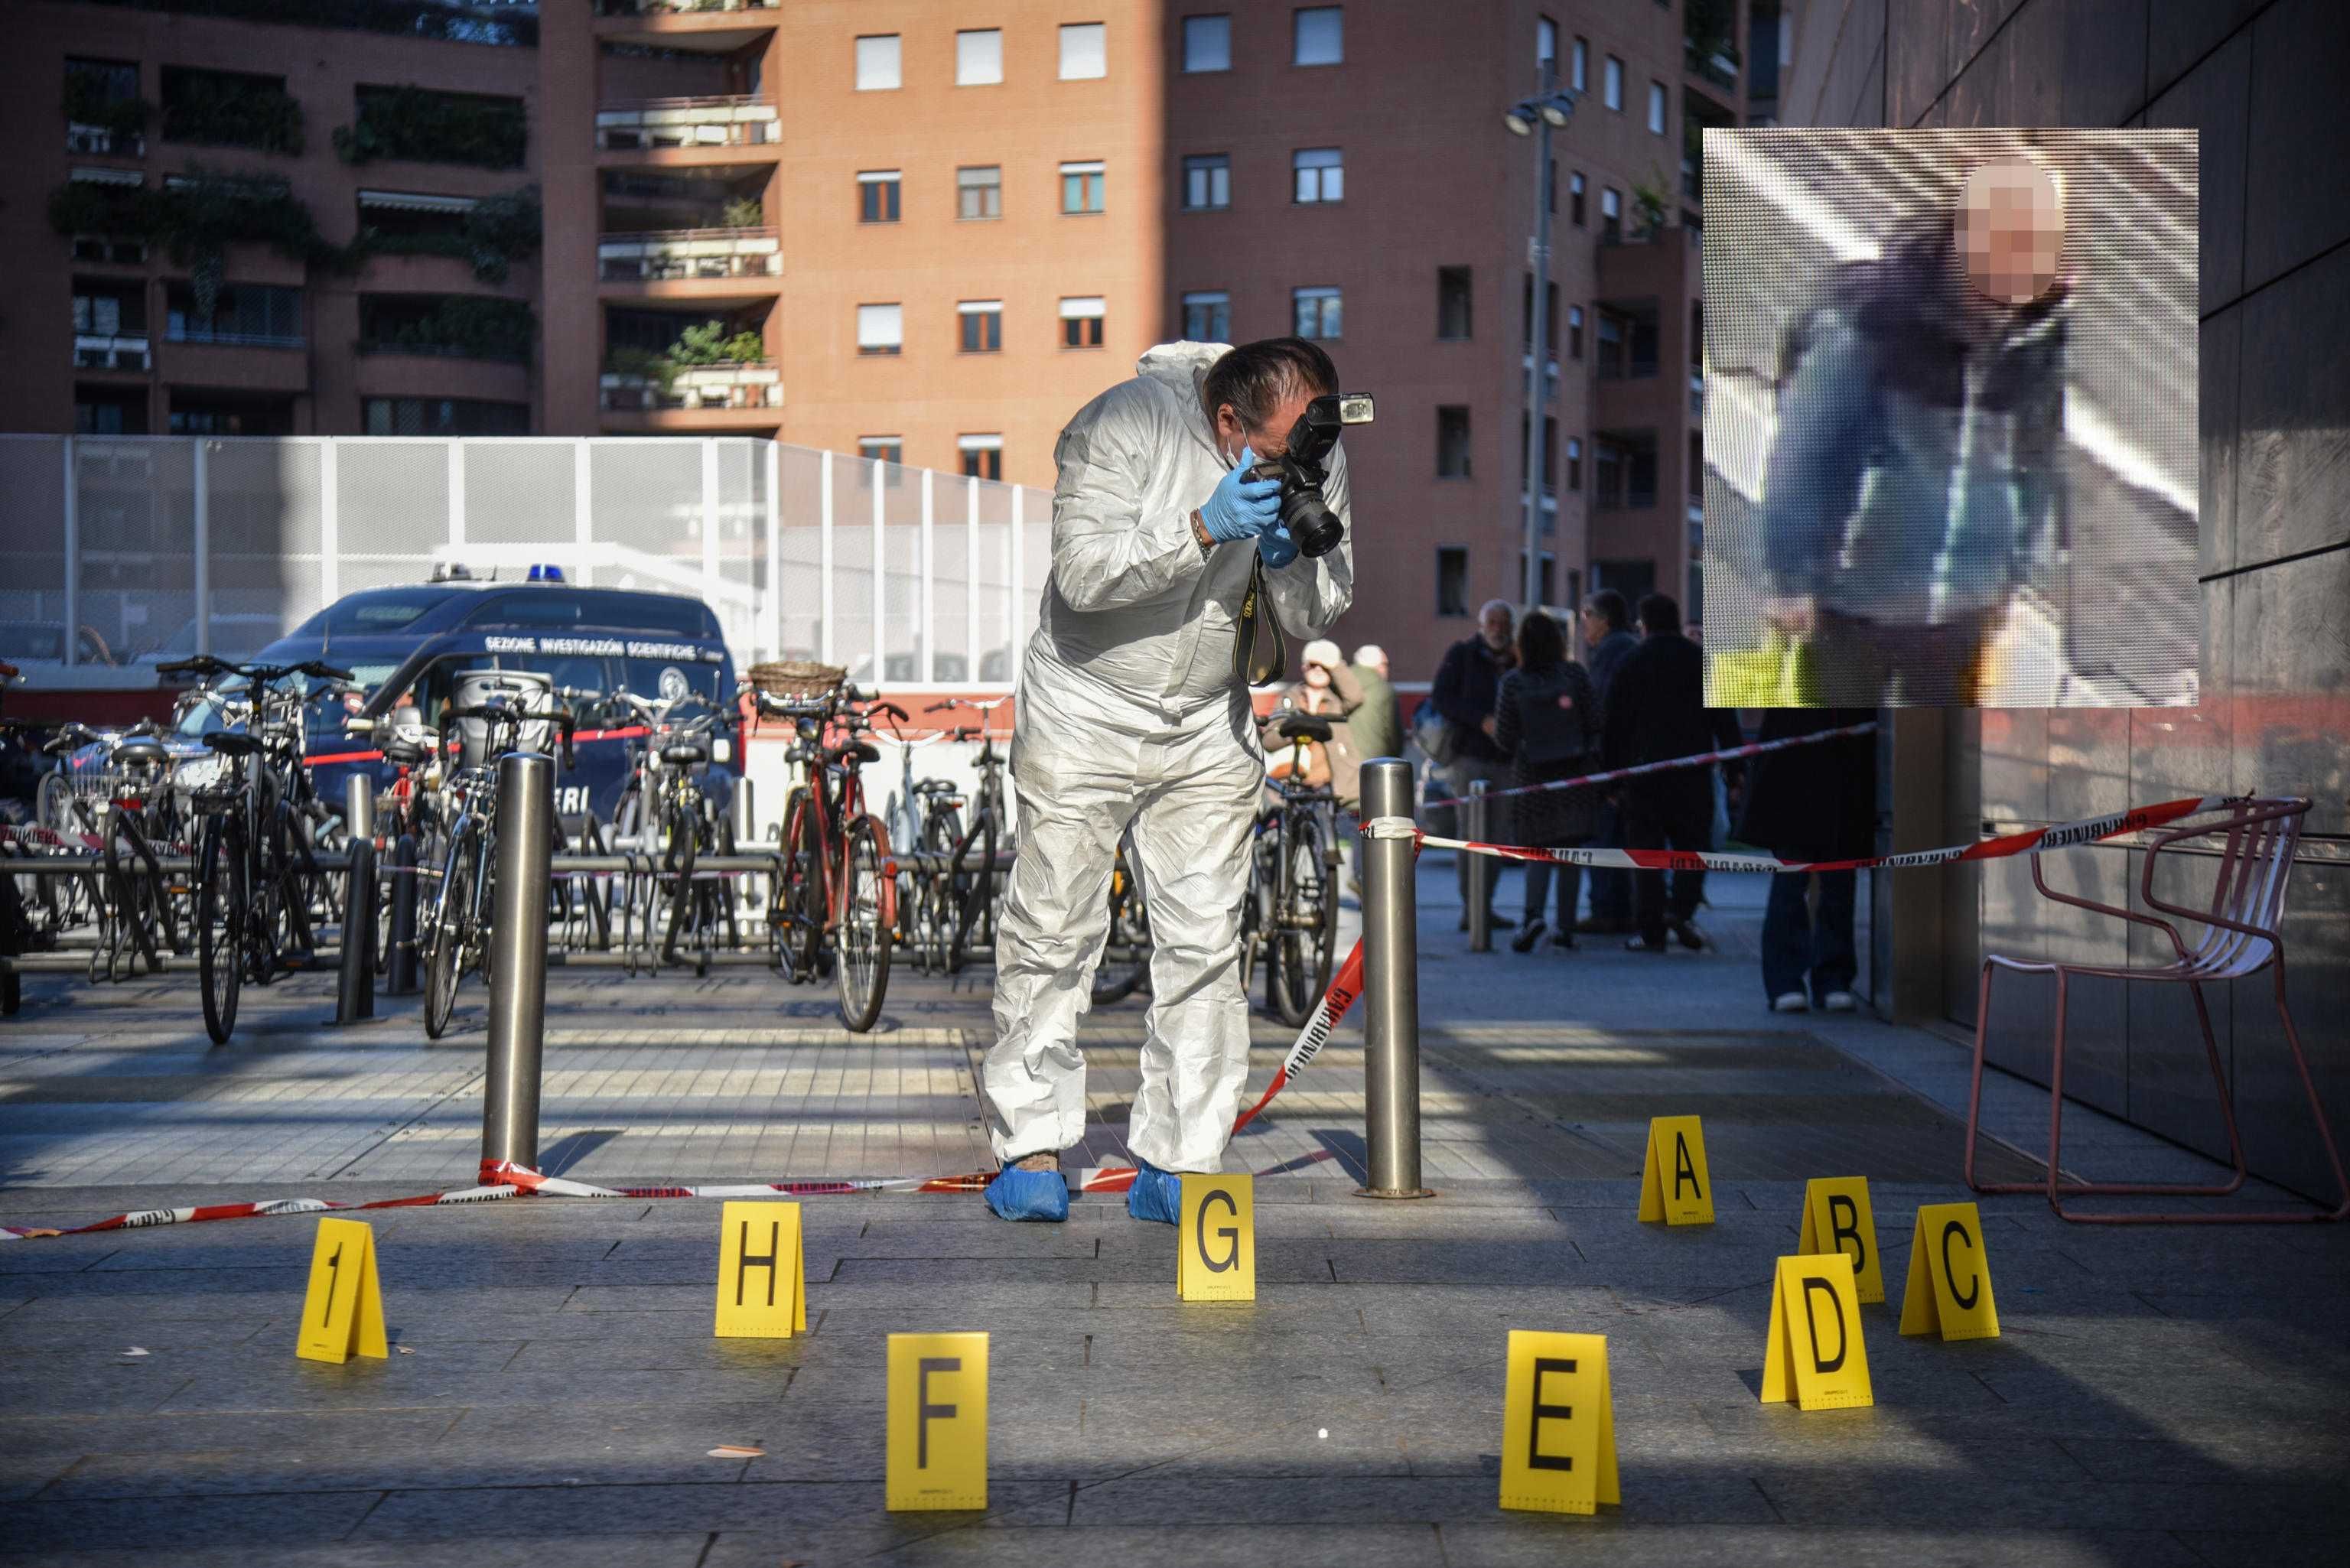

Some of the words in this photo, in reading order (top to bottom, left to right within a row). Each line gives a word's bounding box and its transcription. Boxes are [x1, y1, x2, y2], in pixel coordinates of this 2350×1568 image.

[2041, 813, 2148, 848] CARABINIERI
[1675, 1132, 1701, 1200] A
[737, 1222, 778, 1306] H
[1196, 1189, 1238, 1273] G
[1828, 1195, 1865, 1274] B
[1942, 1221, 1979, 1310] C
[1802, 1277, 1846, 1374] D
[918, 1358, 962, 1469] F
[1528, 1358, 1577, 1472] E
